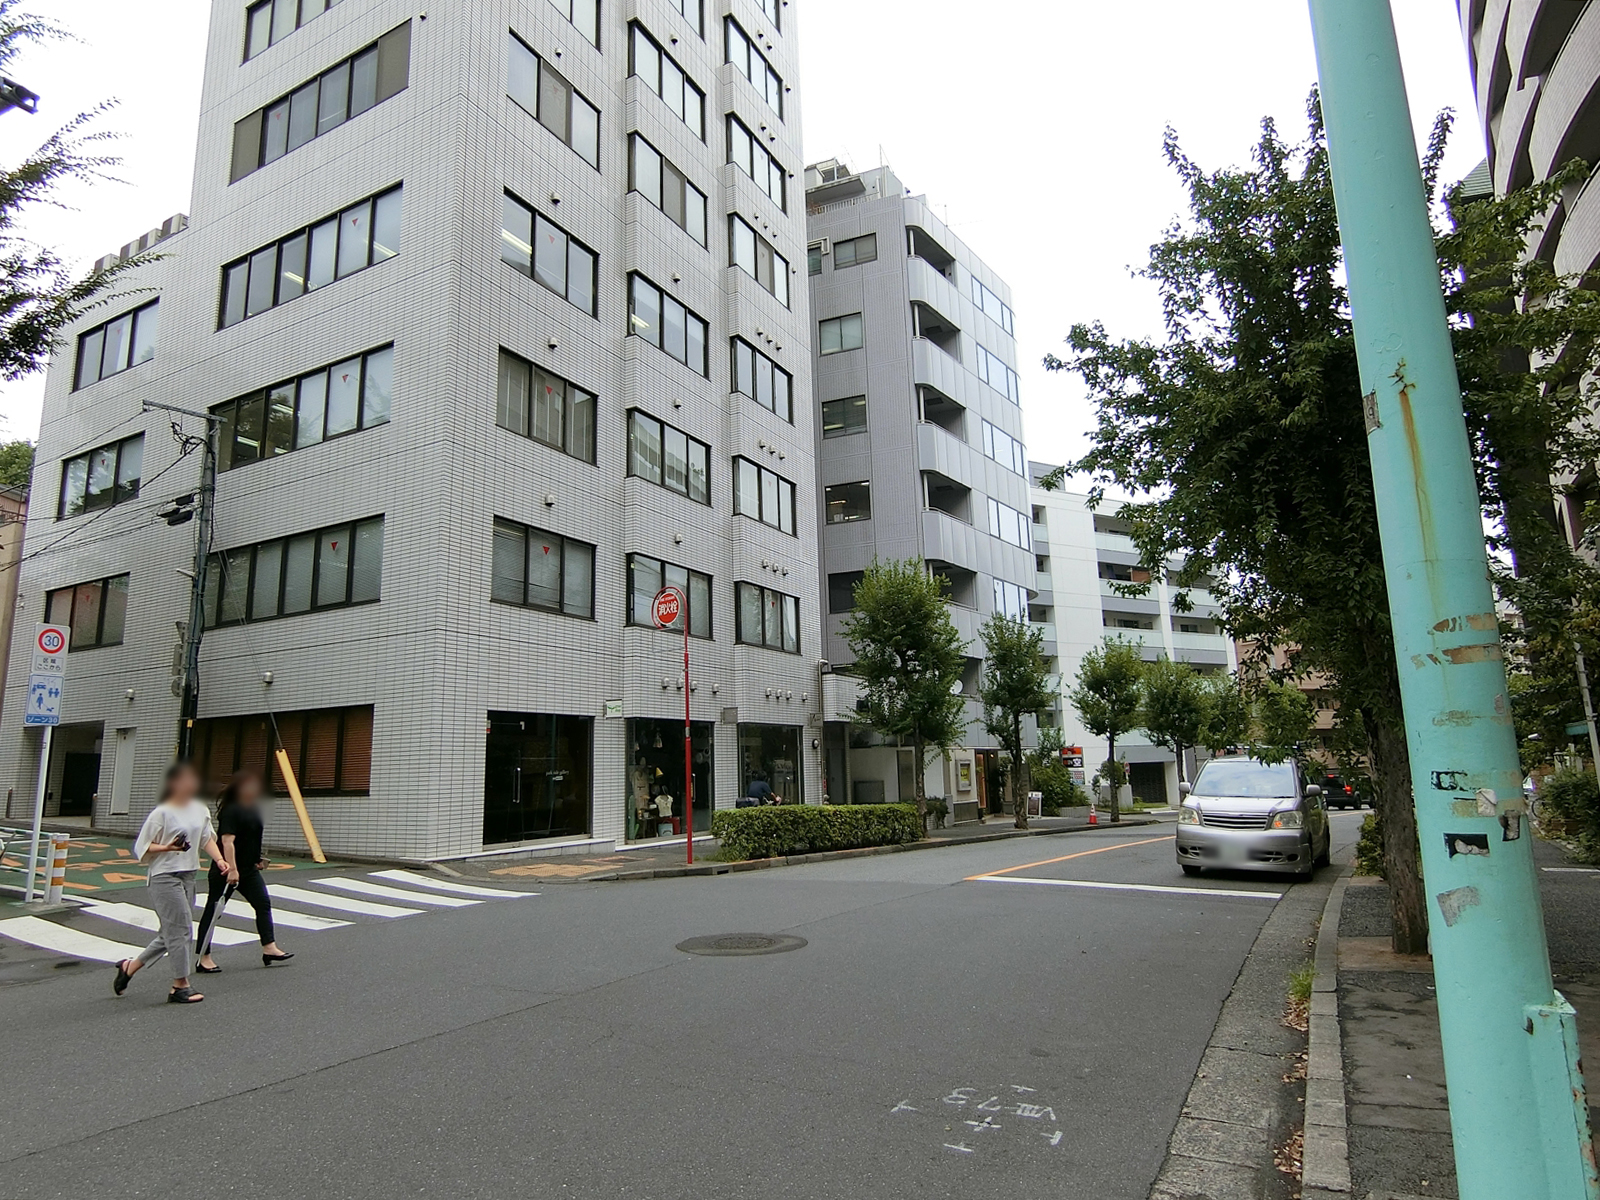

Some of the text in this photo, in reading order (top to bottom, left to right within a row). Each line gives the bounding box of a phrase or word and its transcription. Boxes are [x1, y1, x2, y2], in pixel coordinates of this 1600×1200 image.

[658, 599, 678, 616] 消火栓
[44, 635, 60, 647] 30
[36, 663, 61, 671] ここから
